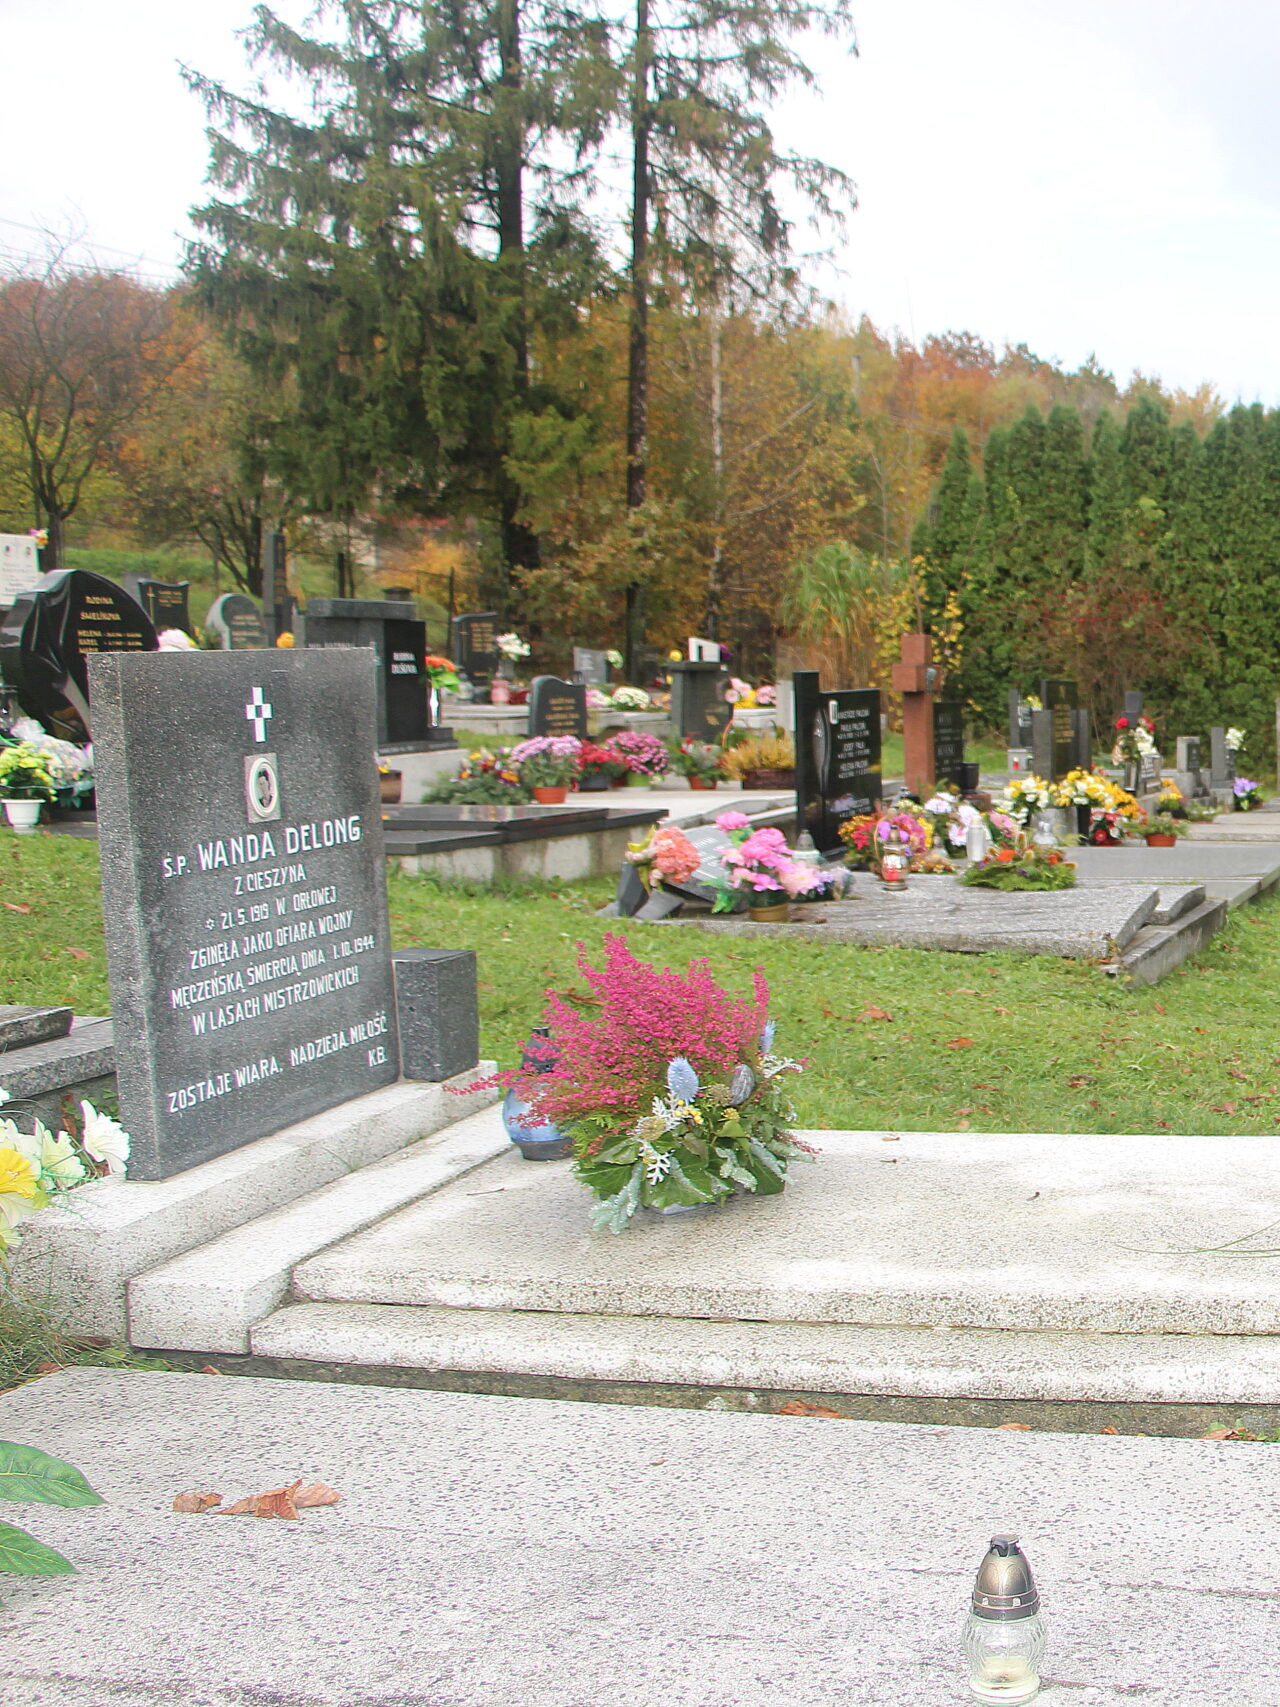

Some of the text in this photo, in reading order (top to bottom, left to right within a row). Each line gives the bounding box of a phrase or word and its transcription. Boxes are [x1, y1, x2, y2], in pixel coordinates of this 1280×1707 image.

[197, 831, 277, 871] WANDA
[285, 815, 362, 855] DELONG
[234, 863, 307, 896] Z CIESZYNA
[275, 896, 287, 916] W
[243, 931, 274, 957] JAKO
[276, 920, 317, 948] OFIARA
[317, 910, 354, 936] WOJNY
[301, 948, 326, 970] DNIA
[192, 964, 360, 1036] W LASACH MISTRZOWICKICH
[167, 1072, 232, 1114] ZOSTAJE
